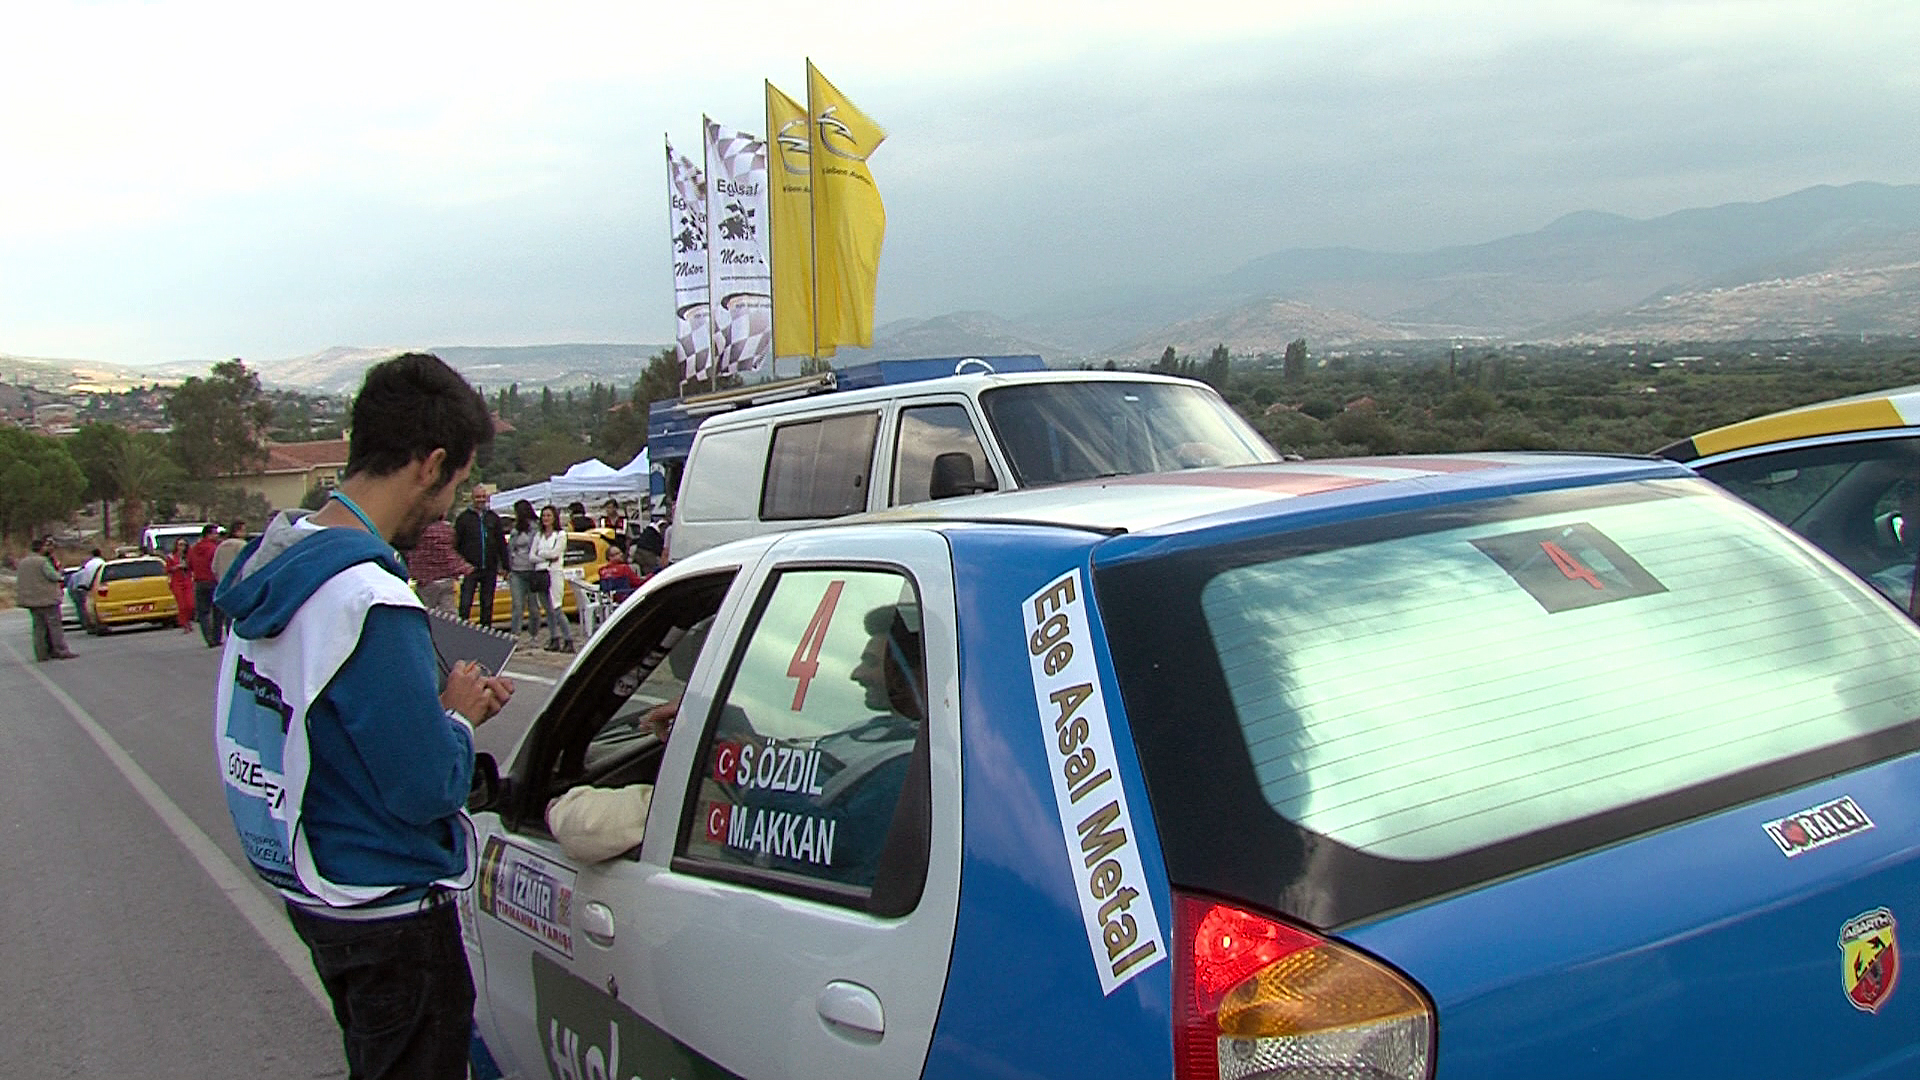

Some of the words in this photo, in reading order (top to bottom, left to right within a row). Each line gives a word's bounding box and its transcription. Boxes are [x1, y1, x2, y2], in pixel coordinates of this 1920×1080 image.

[720, 248, 754, 264] Motor
[1540, 540, 1604, 590] 4
[786, 580, 845, 712] 4
[1030, 576, 1076, 676] Ege
[736, 738, 823, 796] S.ÖZDİL
[1049, 682, 1113, 805] Asal
[727, 804, 836, 866] M.AKKAN
[1797, 801, 1865, 840] RALLY
[512, 864, 552, 920] İZMİR
[1077, 800, 1157, 978] Metal
[1844, 913, 1889, 938] ABARTH
